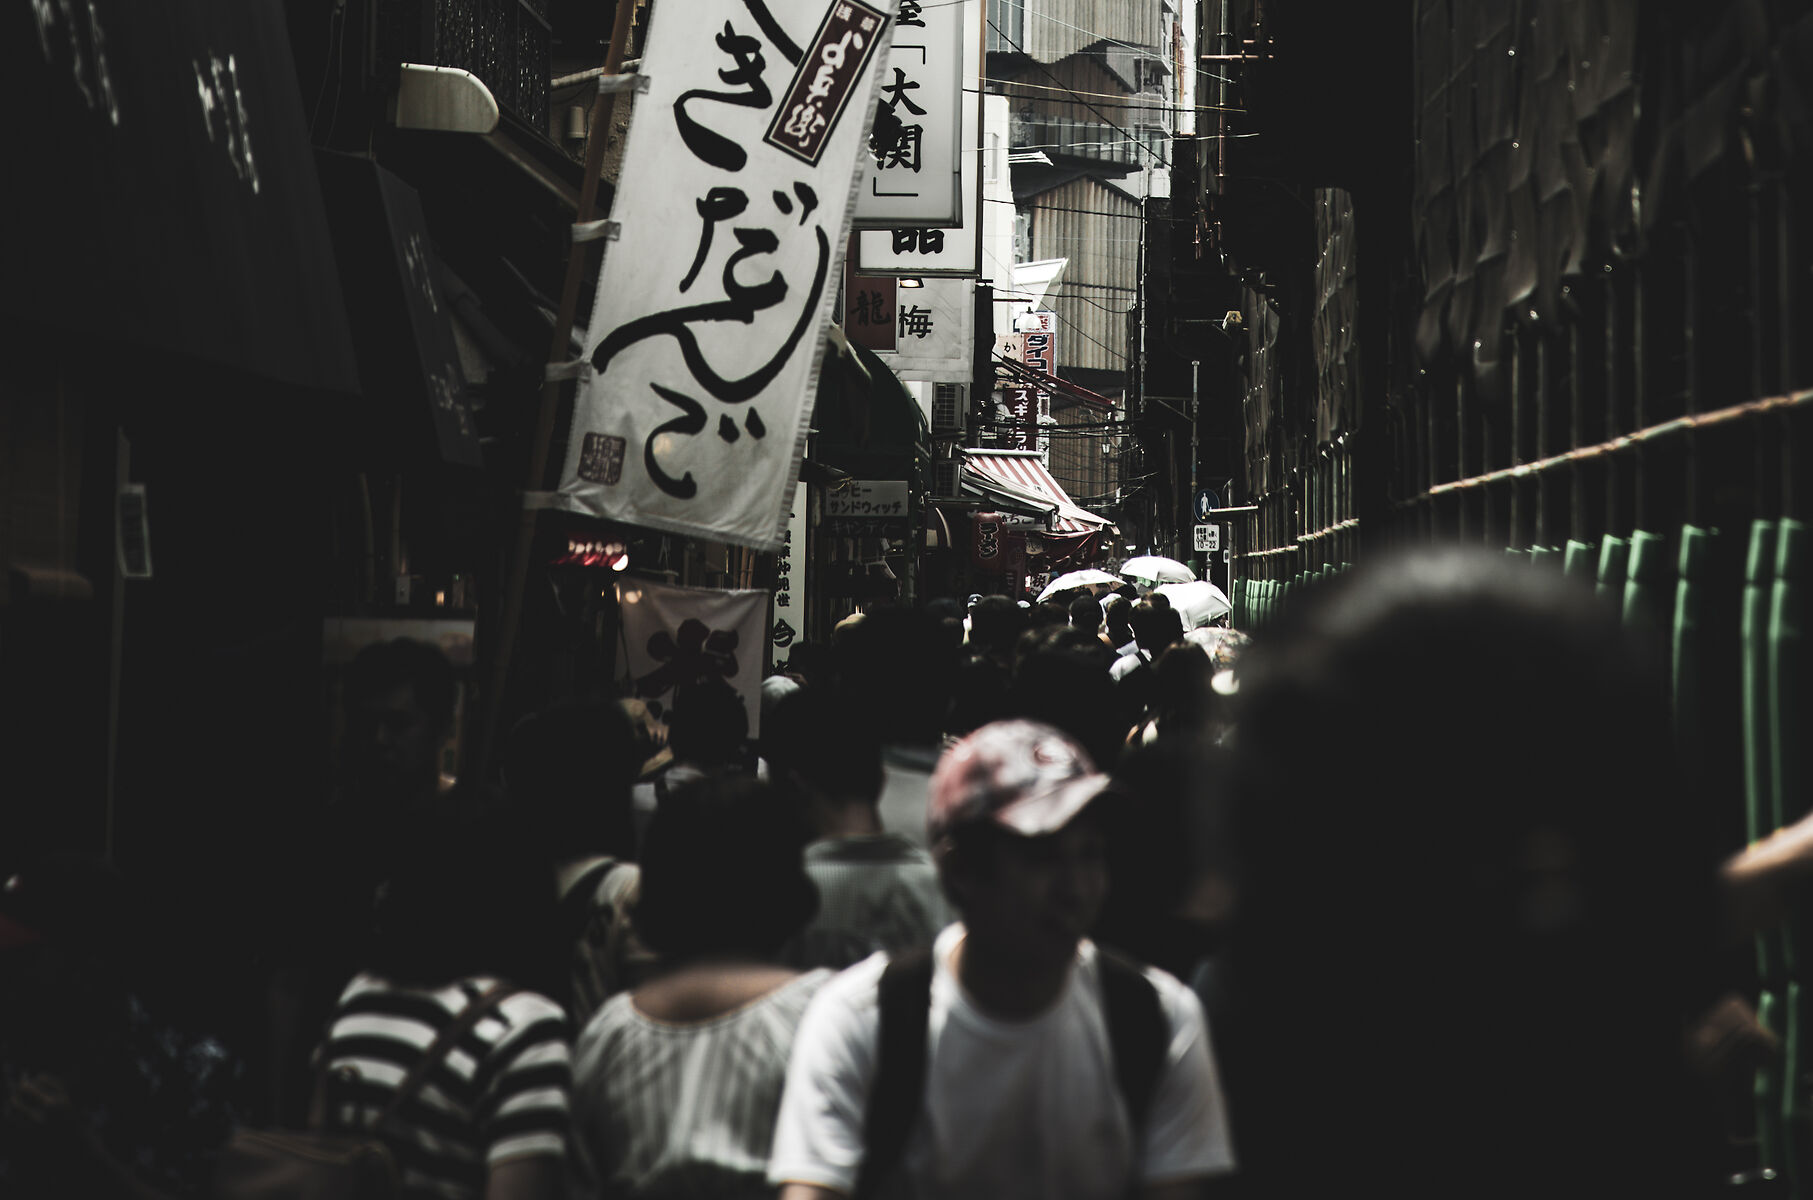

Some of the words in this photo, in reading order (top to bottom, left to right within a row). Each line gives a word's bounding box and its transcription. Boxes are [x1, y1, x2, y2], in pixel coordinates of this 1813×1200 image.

[830, 501, 902, 514] サンドウィッチ
